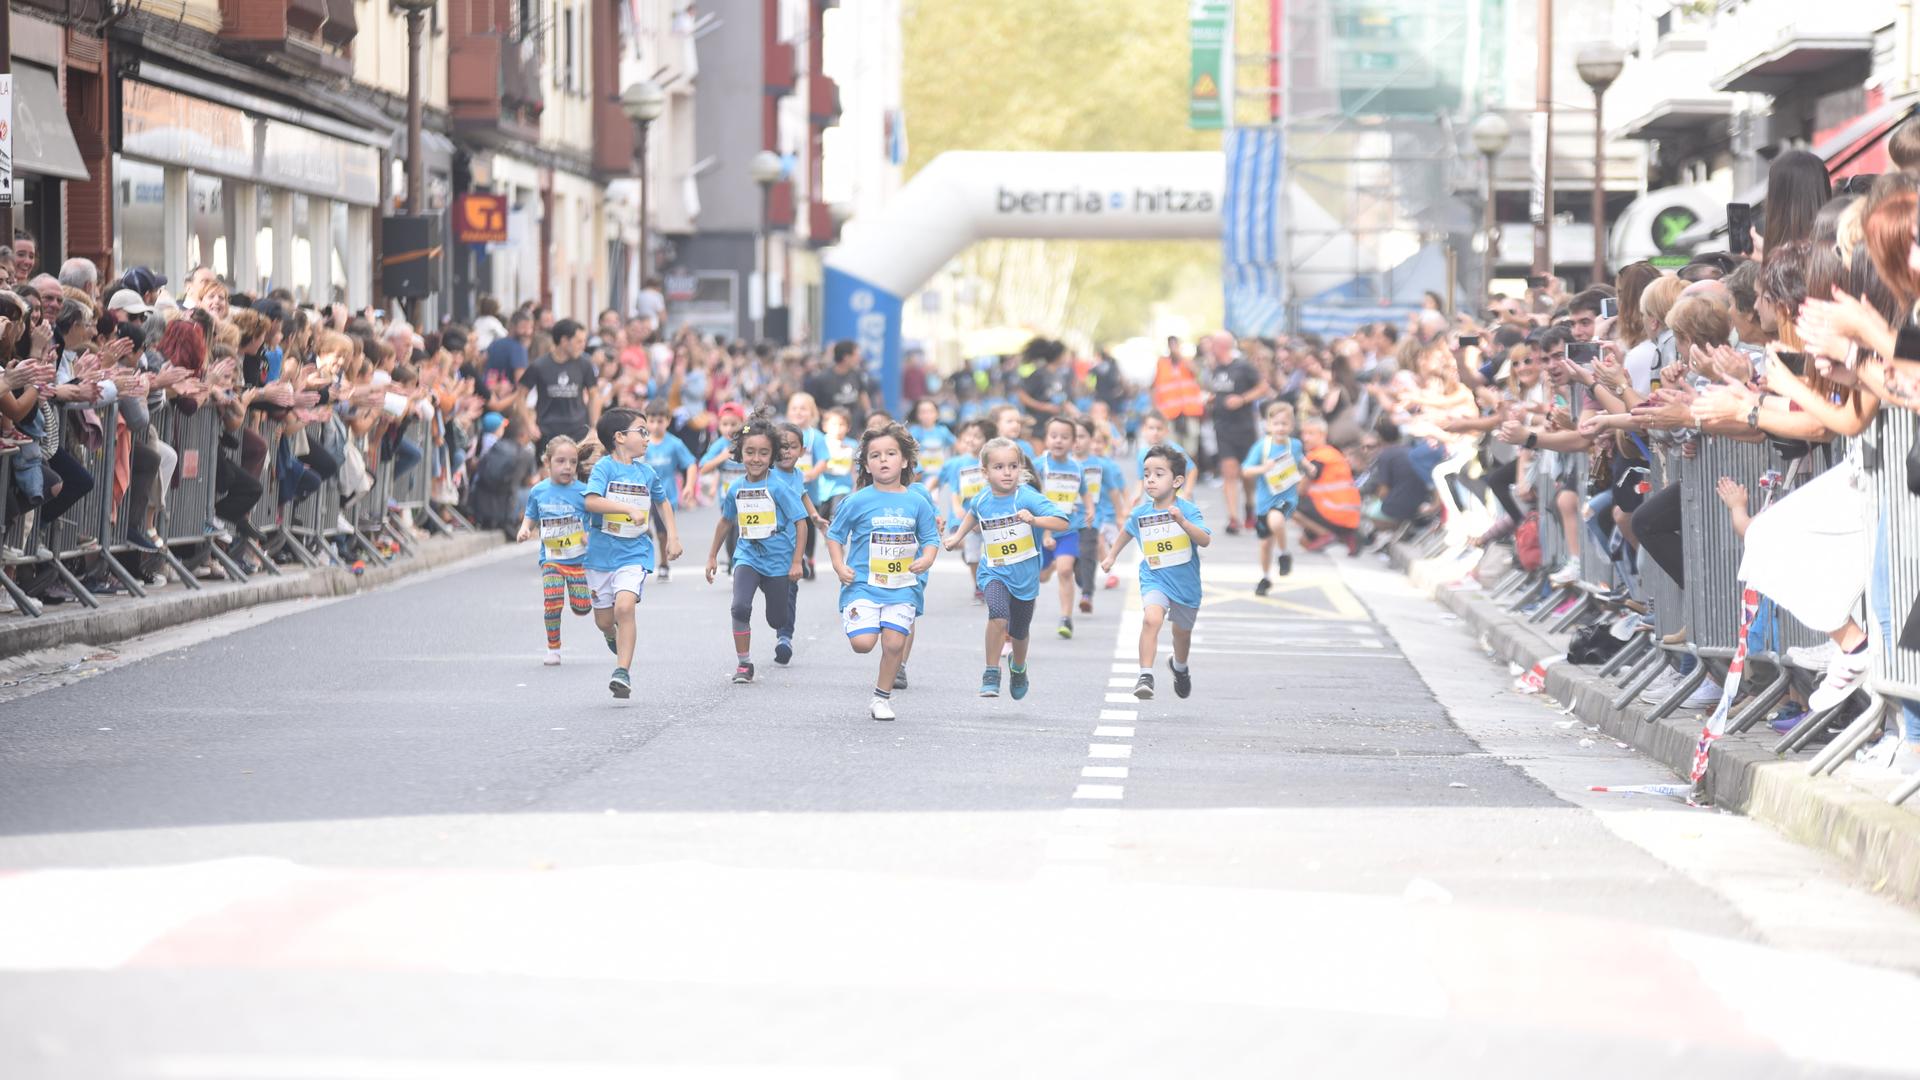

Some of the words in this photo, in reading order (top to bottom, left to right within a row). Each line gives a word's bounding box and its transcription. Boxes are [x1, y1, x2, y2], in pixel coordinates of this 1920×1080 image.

[997, 184, 1103, 214] berria
[1134, 185, 1214, 212] hitza
[746, 514, 759, 524] 22
[1001, 543, 1018, 555] 89
[1156, 541, 1173, 552] 86
[887, 561, 902, 573] 98
